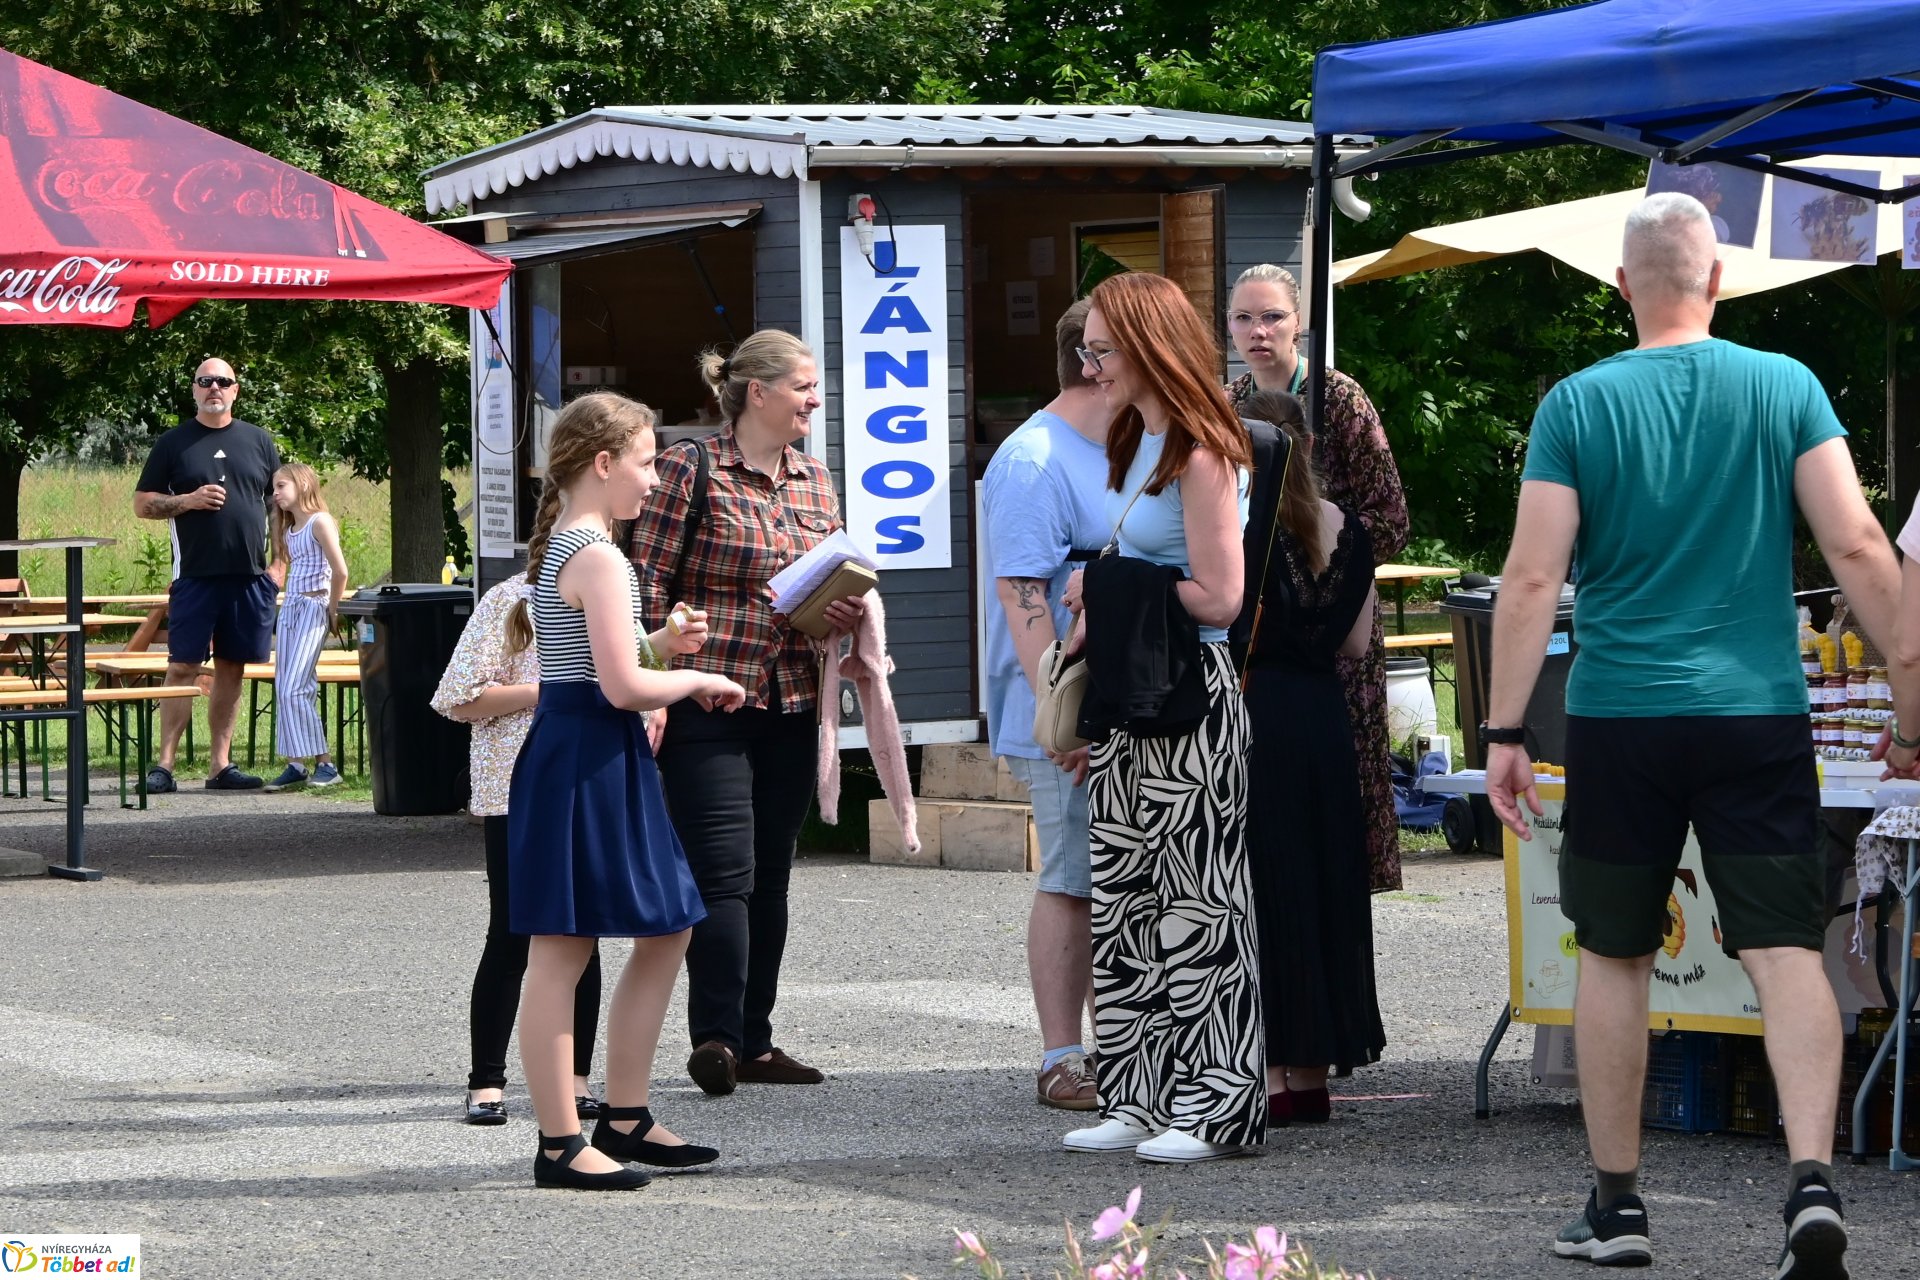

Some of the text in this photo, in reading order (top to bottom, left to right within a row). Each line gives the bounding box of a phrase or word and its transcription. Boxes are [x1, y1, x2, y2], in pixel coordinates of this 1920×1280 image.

[170, 260, 330, 287] SOLD HERE
[859, 240, 936, 555] LÁNGOS
